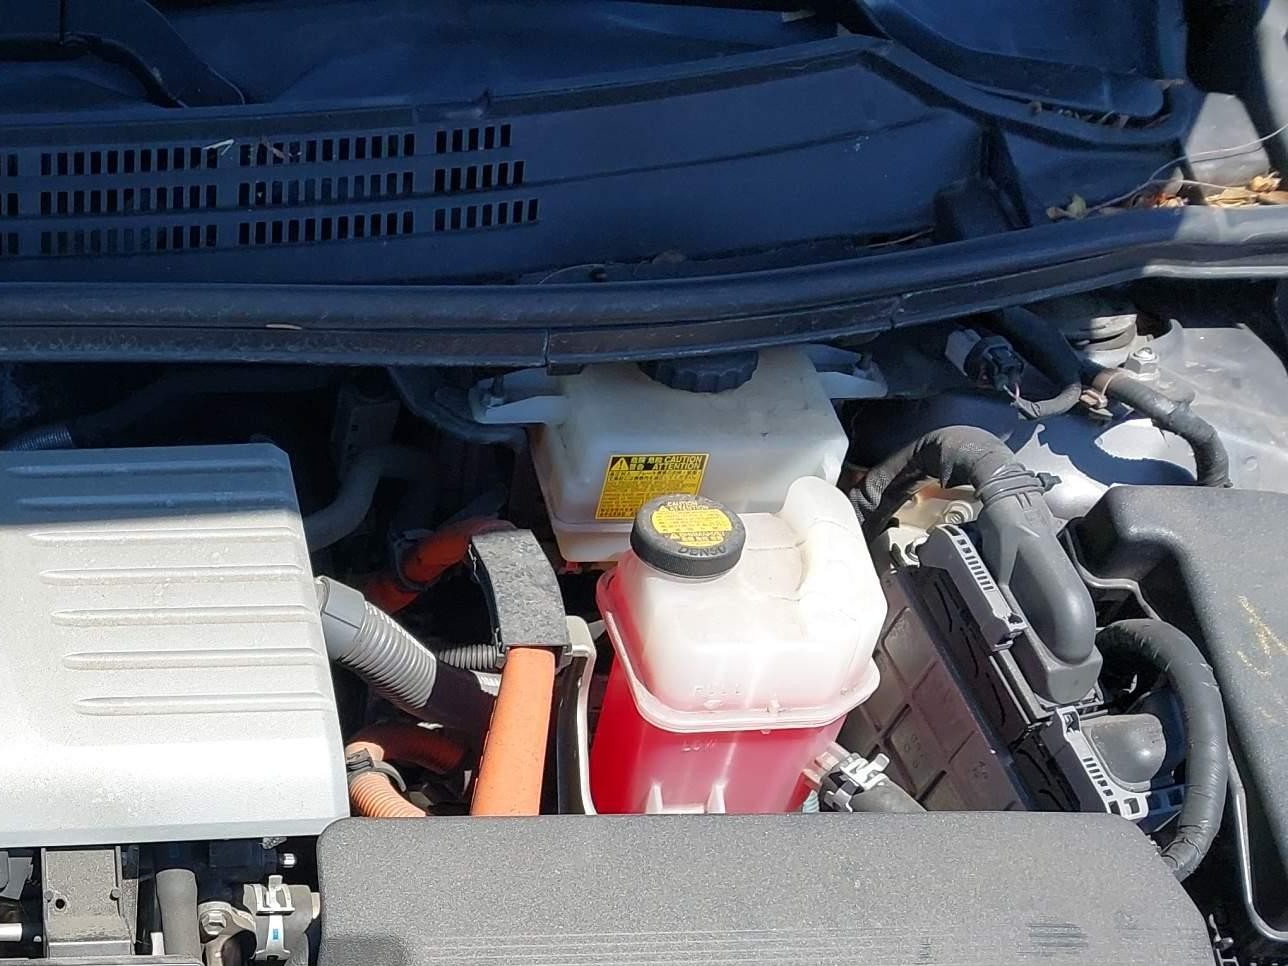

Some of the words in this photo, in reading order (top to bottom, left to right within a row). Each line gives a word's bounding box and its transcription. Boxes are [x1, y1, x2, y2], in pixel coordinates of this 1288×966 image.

[664, 455, 703, 464] CAUTION
[652, 463, 701, 471] ATTENTION
[678, 545, 727, 557] DENSO
